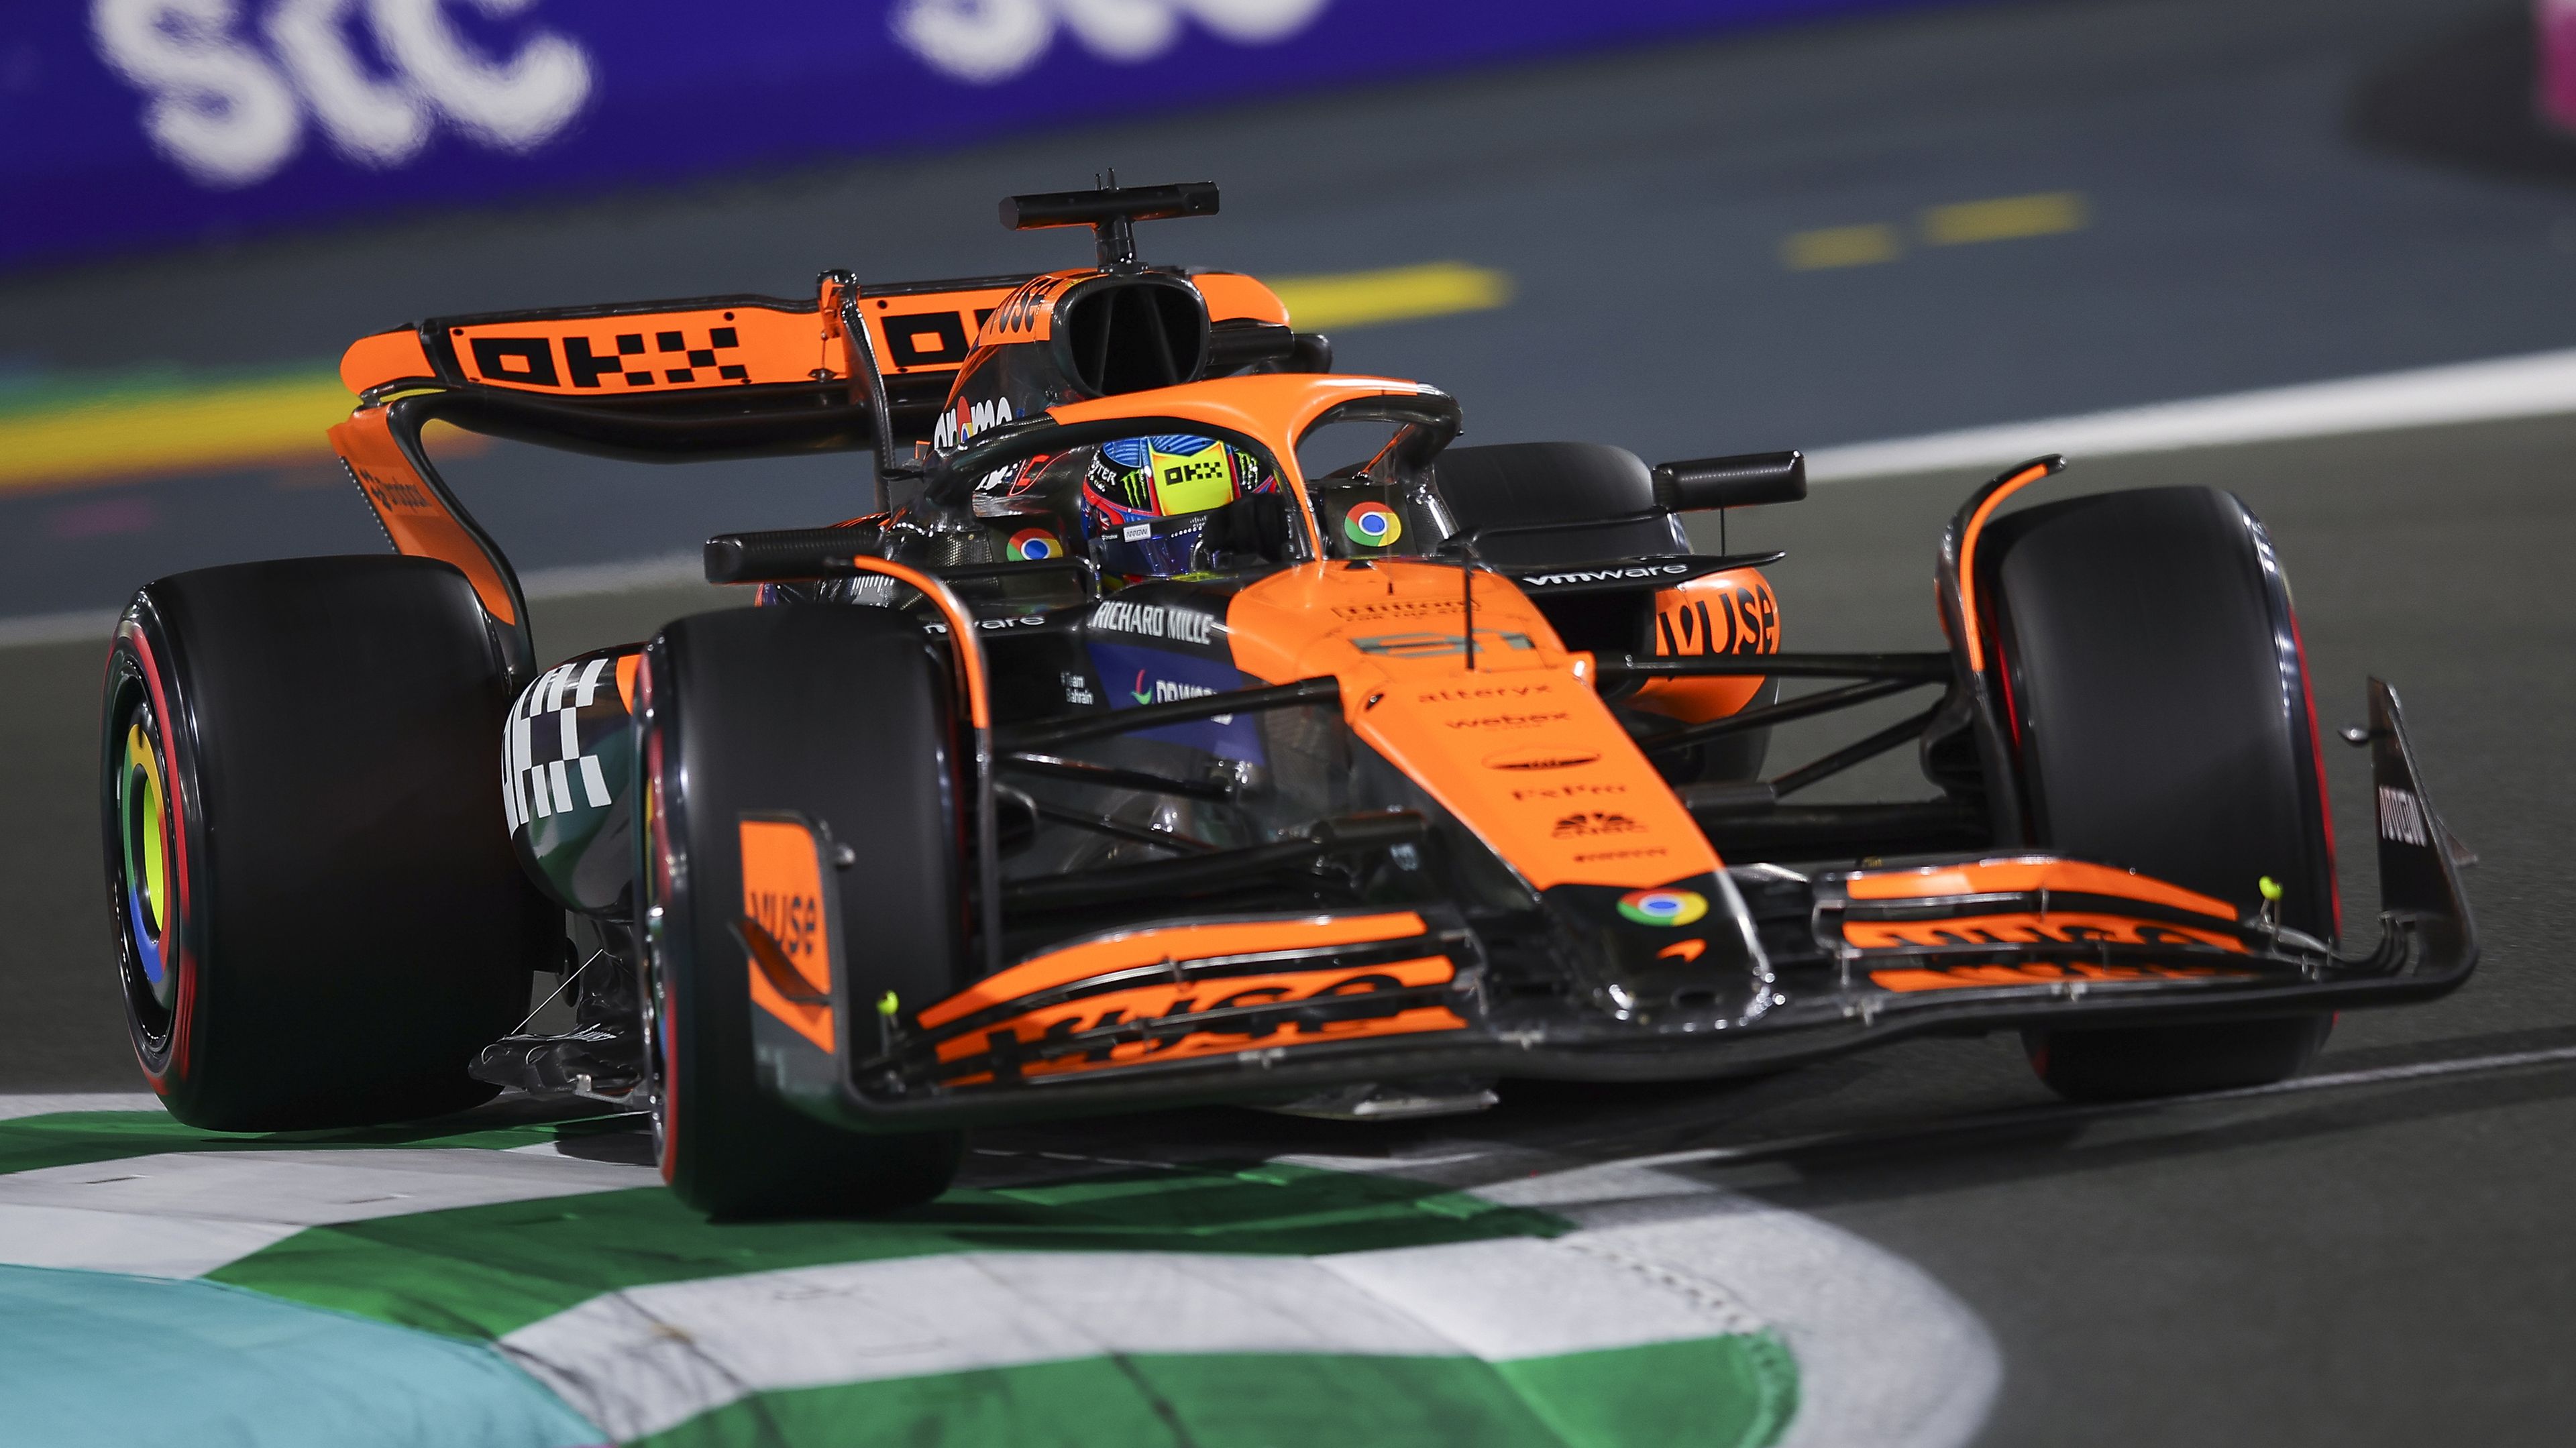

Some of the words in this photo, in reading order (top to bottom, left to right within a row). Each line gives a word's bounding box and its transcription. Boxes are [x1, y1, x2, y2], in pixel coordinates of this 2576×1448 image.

[471, 327, 747, 387] OKX
[1164, 461, 1222, 486] OKX
[1523, 563, 1688, 586] vmware
[1093, 600, 1165, 637] RICHARD
[1167, 609, 1215, 645] MILLE
[1066, 688, 1094, 705] Bahrain
